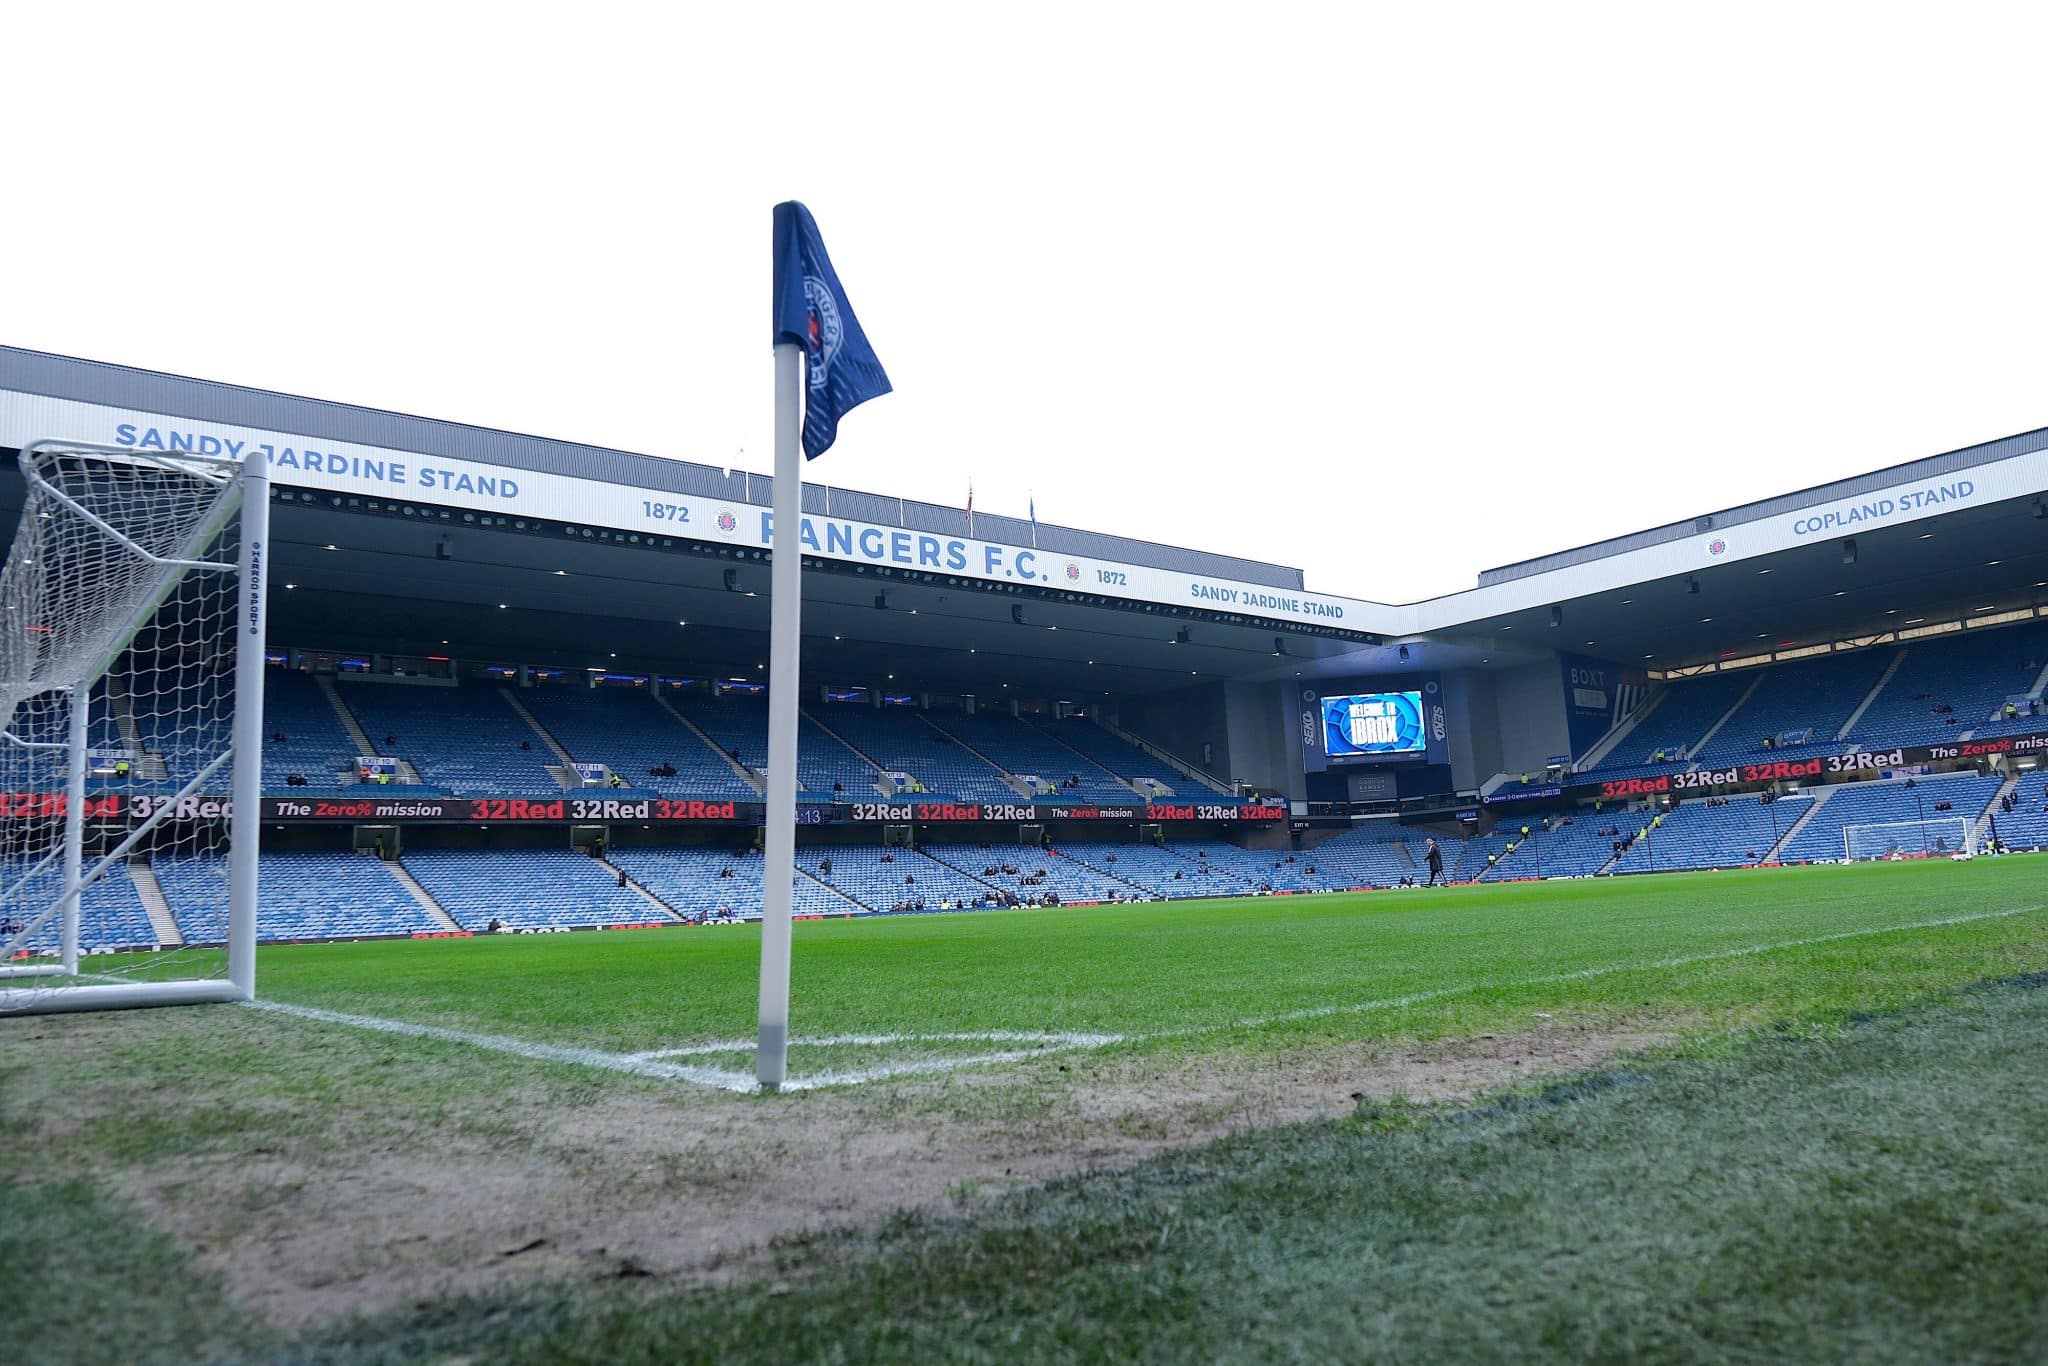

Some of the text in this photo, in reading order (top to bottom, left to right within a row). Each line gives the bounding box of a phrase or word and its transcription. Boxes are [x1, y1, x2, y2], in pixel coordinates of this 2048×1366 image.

[115, 423, 519, 498] SANDY JARDINE STAND
[643, 501, 690, 523] 1872
[1794, 481, 1974, 535] COPLAND STAND
[984, 545, 1048, 582] F.C.
[249, 551, 260, 626] HARROD SPORT
[1097, 569, 1127, 587] 1872
[1191, 583, 1344, 618] SANDY JARDINE STAND
[1571, 667, 1605, 688] BOXT
[1303, 711, 1315, 746] SEKO
[1351, 715, 1399, 745] IBROX
[1432, 705, 1447, 741] SEKO
[1930, 747, 1959, 760] The
[1962, 739, 2011, 756] Zero%
[1602, 775, 1669, 797] 32Red
[1673, 767, 1739, 788] 32Red
[1744, 757, 1822, 782] 32Red
[1828, 749, 1904, 773] 32Red
[0, 792, 119, 817] 2Rd
[277, 802, 443, 817] The Zero% mission
[471, 800, 735, 819] 32Red 32Red 32Red
[853, 804, 1036, 820] 32Red 32Red 32Red
[1052, 807, 1133, 819] The Zero% mission
[1147, 805, 1283, 820] 32Red 32Red 32Red
